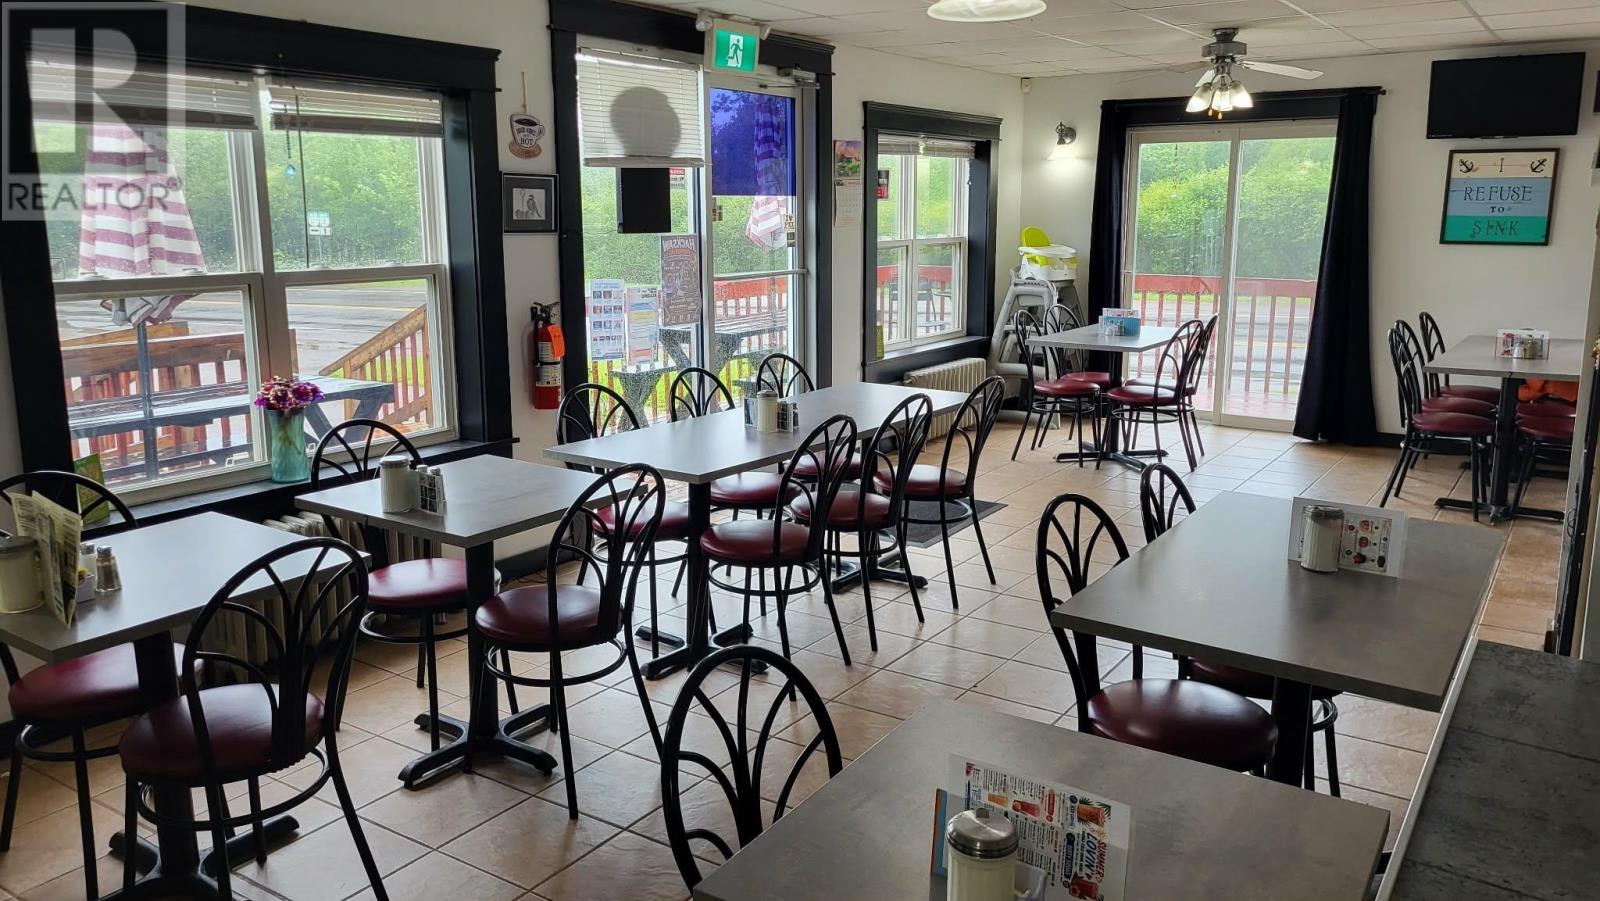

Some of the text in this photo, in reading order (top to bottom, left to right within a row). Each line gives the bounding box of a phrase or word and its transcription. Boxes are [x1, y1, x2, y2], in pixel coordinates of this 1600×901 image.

[1499, 157, 1505, 173] I
[1463, 185, 1533, 201] REFUSE
[1490, 206, 1505, 214] TO
[1472, 220, 1519, 236] SINK
[1095, 840, 1107, 878] SUMMER
